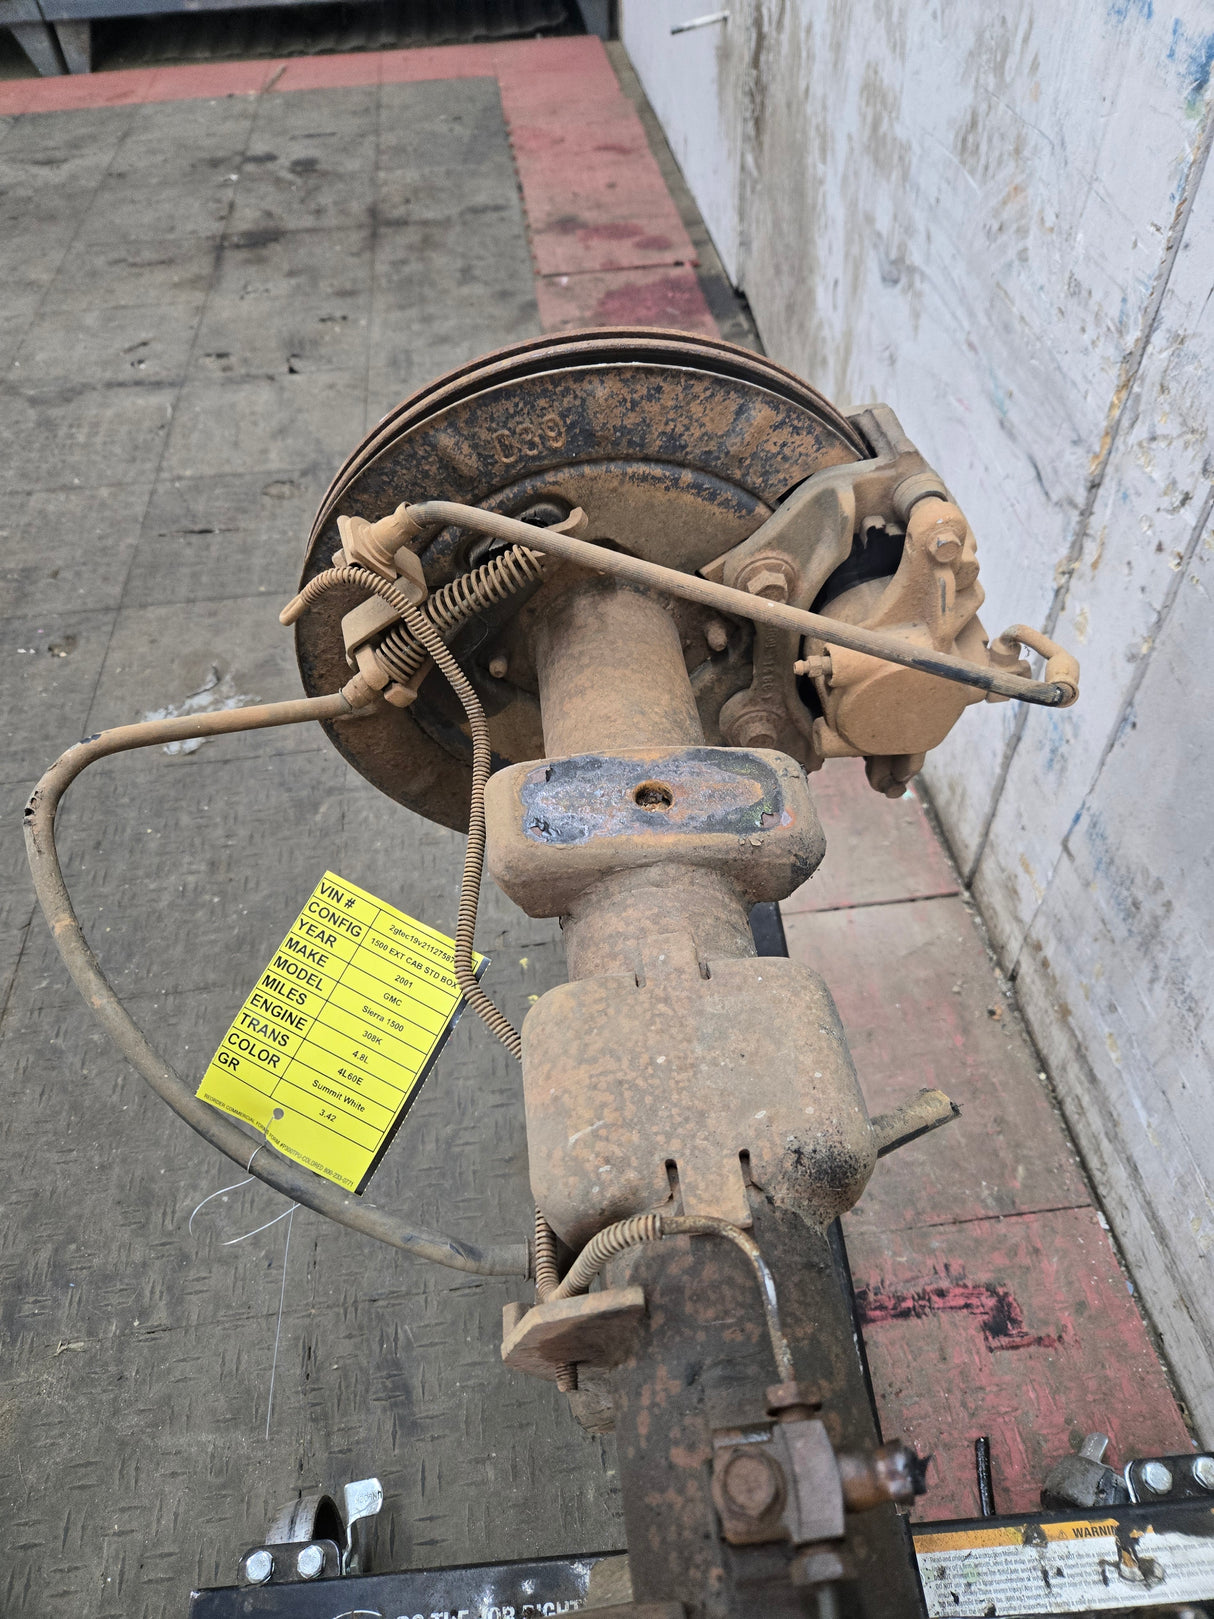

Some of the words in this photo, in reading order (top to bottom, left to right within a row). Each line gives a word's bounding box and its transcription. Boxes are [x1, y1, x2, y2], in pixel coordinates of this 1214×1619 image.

[320, 882, 344, 903] VIN
[344, 897, 356, 909] #
[297, 918, 337, 948] YEAR
[308, 901, 362, 937] CONFIG
[285, 937, 329, 968] MAKE
[371, 938, 388, 951] 1500
[389, 947, 405, 960] EXT
[406, 957, 423, 970] CAB
[423, 967, 440, 979] STD
[440, 975, 458, 989] BOX
[273, 956, 324, 991] MODEL
[394, 974, 413, 989] 2001
[262, 974, 307, 1005] MILES
[383, 992, 402, 1007] GMC
[250, 993, 307, 1031] ENGINE
[362, 1005, 384, 1022] Sierra
[386, 1019, 404, 1032] 1500
[240, 1012, 289, 1047] TRANS
[362, 1030, 383, 1045] 308K
[218, 1052, 240, 1071] GR
[228, 1033, 280, 1068] COLOR
[352, 1050, 369, 1064] 4.8L
[337, 1067, 364, 1086] 4L60E
[312, 1079, 343, 1100] Summit
[343, 1095, 366, 1113] White
[319, 1108, 337, 1123] 3.42
[1072, 1525, 1118, 1538] WARNIN
